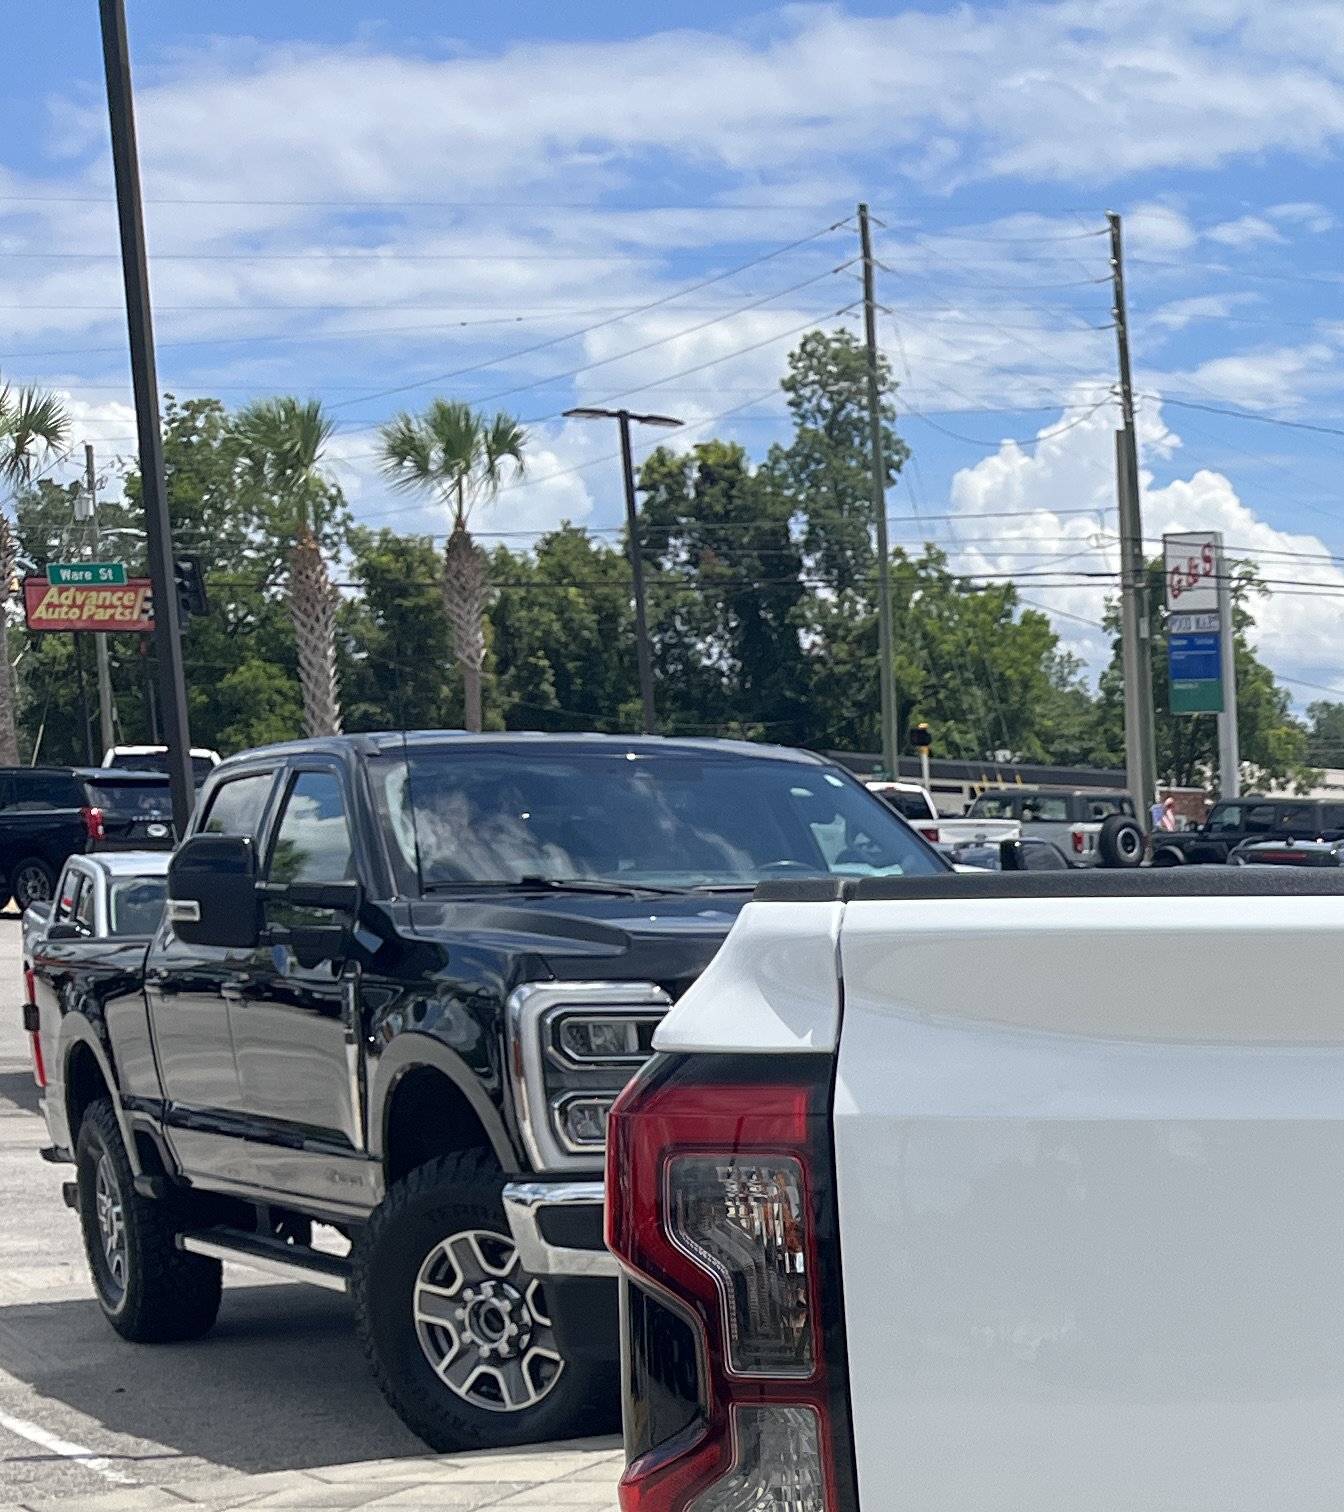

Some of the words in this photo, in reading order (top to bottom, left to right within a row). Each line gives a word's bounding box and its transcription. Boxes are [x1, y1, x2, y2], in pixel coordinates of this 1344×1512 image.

[60, 569, 92, 581] Ware
[98, 567, 114, 581] St
[44, 586, 136, 606] Advance
[31, 603, 80, 620] Auto
[81, 604, 133, 620] Parts
